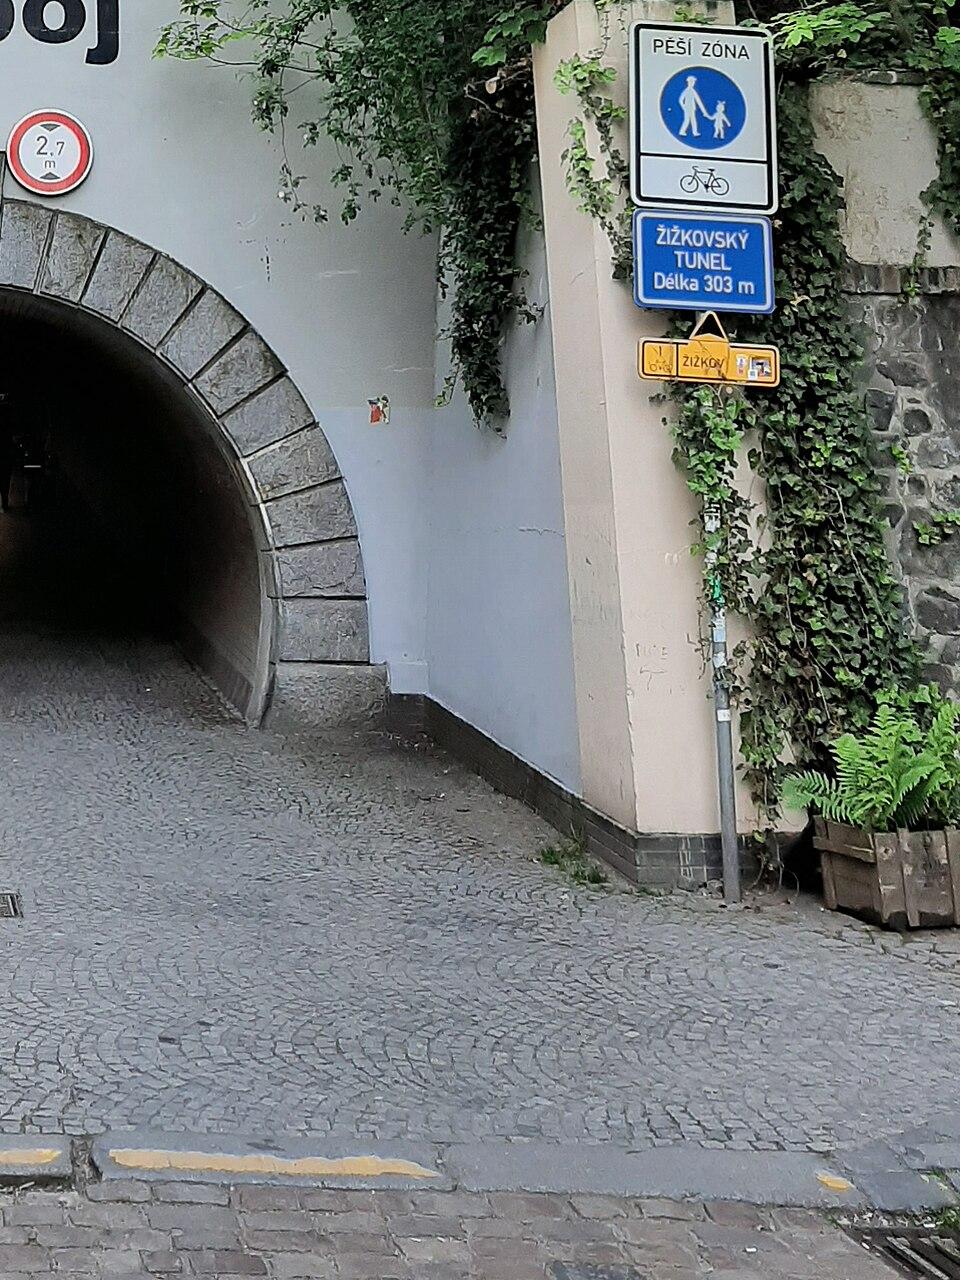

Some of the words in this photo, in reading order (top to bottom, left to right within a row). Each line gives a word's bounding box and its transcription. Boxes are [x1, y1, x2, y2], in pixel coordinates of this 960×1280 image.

[653, 37, 692, 56] PĚŠÍ
[701, 40, 750, 60] ZÓNA
[44, 160, 56, 169] m
[656, 224, 750, 250] ŽIŽKOVSKÝ
[674, 250, 732, 271] TUNEL
[653, 271, 700, 292] Délka
[704, 274, 733, 293] 303
[738, 280, 755, 295] m
[683, 353, 726, 369] ŽIŽKOV
